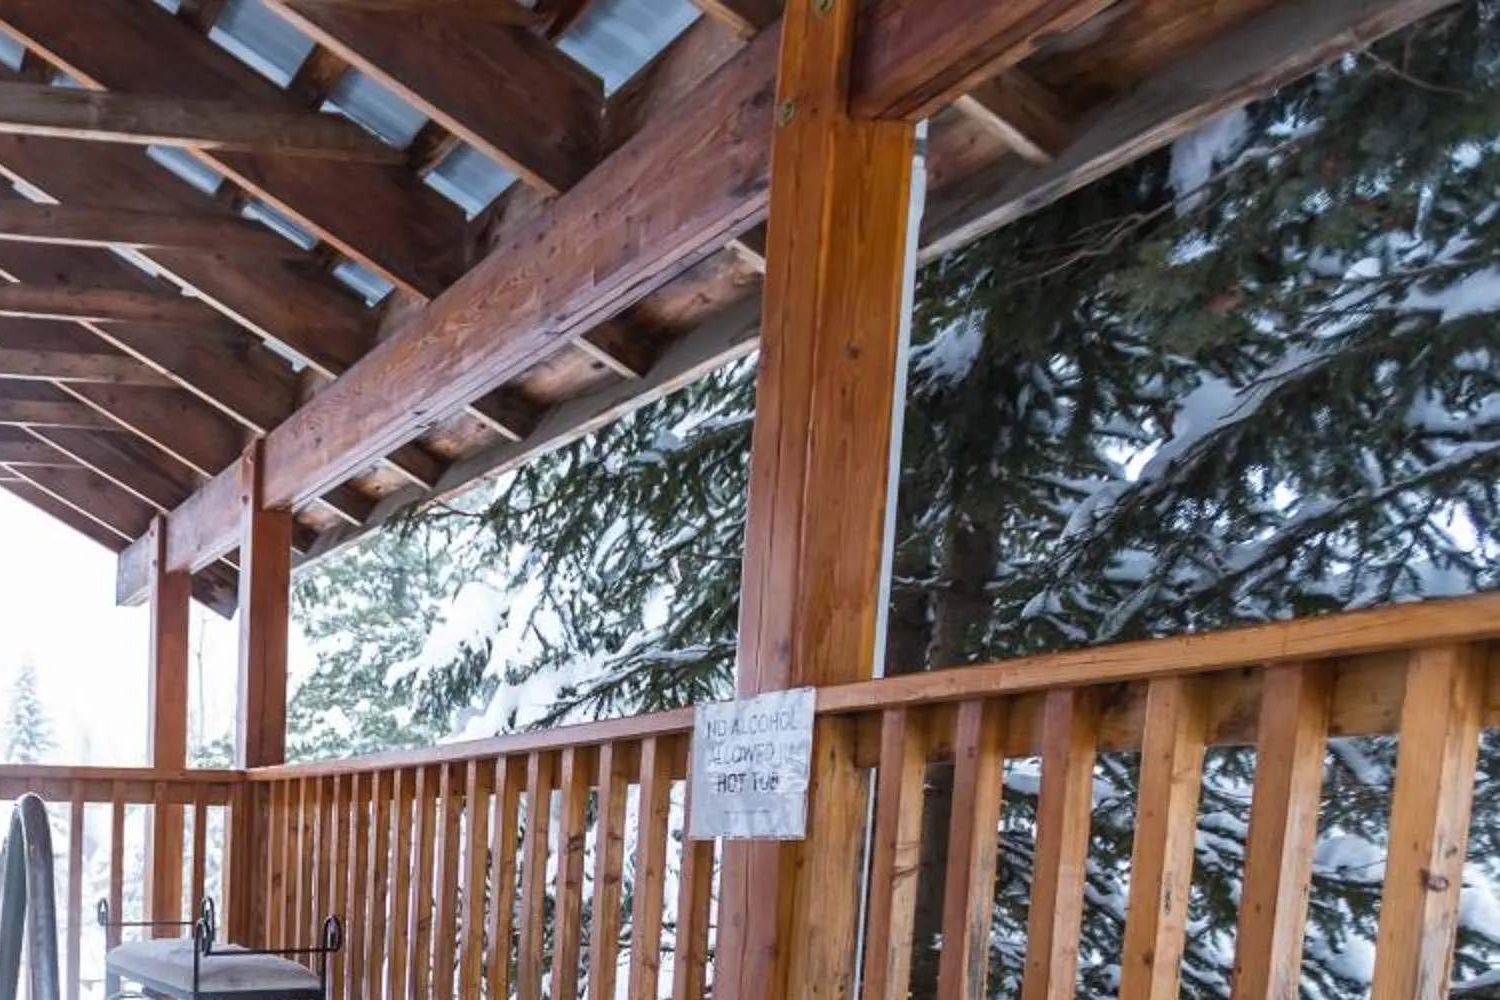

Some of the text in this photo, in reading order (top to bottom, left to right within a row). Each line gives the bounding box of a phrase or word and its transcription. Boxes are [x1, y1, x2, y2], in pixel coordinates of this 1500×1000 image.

[707, 710, 798, 739] NO ALCOHOL
[717, 771, 780, 793] HOT TUB
